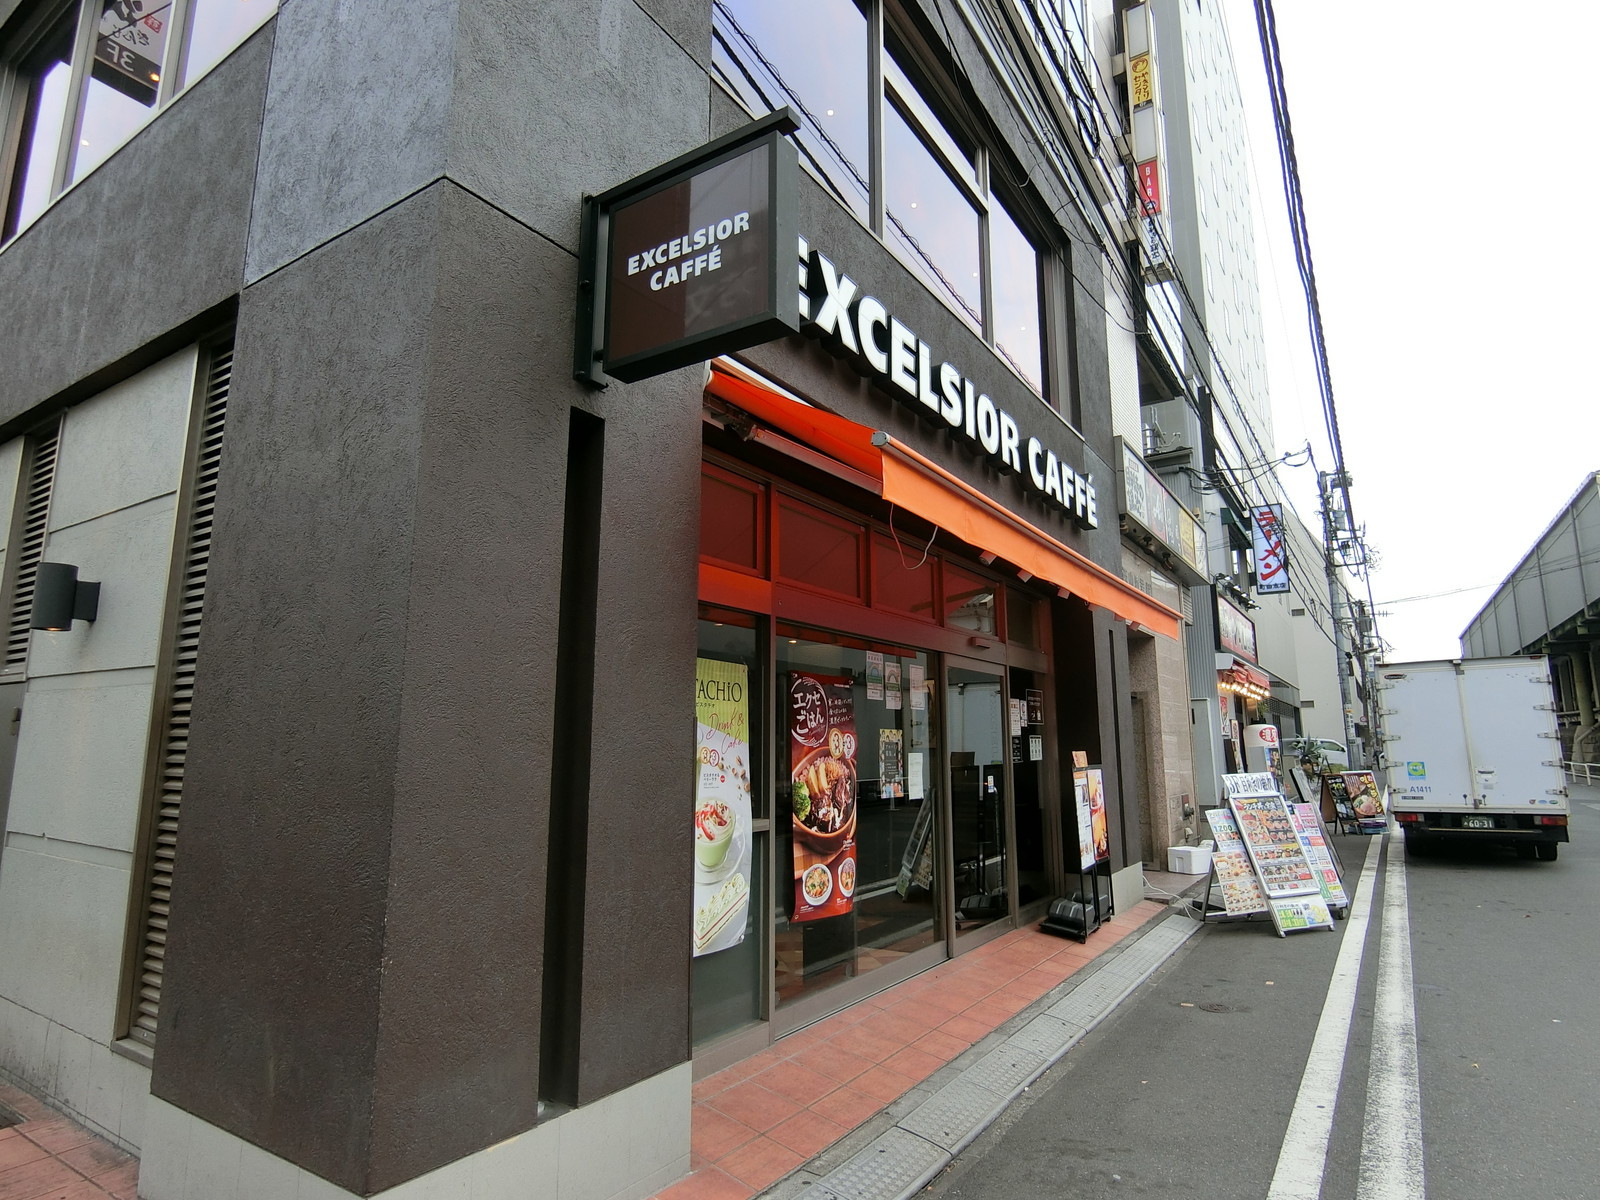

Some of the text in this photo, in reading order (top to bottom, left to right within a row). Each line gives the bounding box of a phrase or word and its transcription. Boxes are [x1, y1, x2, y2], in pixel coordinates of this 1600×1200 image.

[1133, 75, 1142, 102] センター
[1145, 166, 1153, 198] BAR
[627, 211, 750, 276] EXCELSIOR
[650, 245, 722, 292] CAFFÉ
[1027, 436, 1098, 530] CAFFÉ
[793, 691, 821, 709] エクセ
[797, 708, 825, 734] ごはん
[1226, 775, 1241, 794] 3F
[1469, 819, 1493, 828] 60-31
